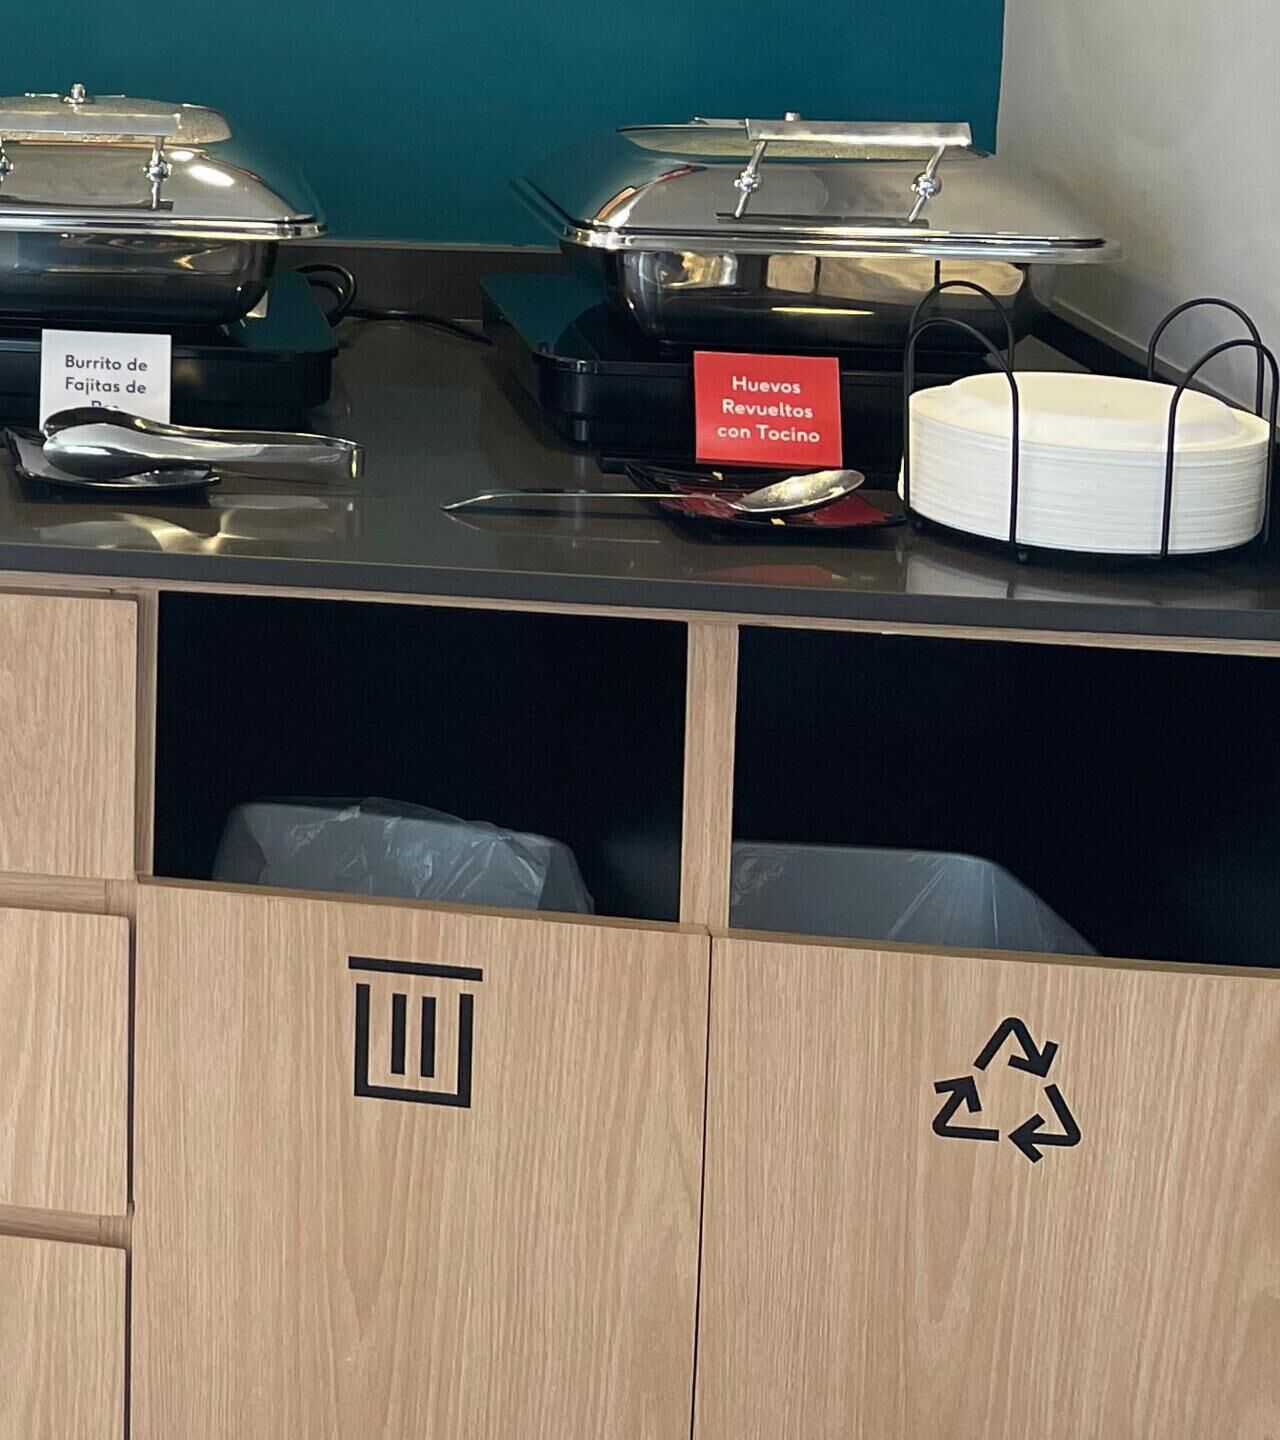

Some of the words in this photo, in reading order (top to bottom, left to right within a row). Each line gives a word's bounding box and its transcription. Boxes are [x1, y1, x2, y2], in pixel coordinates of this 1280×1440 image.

[65, 354, 122, 370] Burrito
[127, 358, 148, 371] de
[65, 376, 120, 395] Fajitas
[126, 380, 147, 394] de
[731, 375, 801, 394] Huevos
[722, 398, 814, 419] Revueltos
[717, 426, 752, 439] con
[756, 424, 821, 443] Tocino
